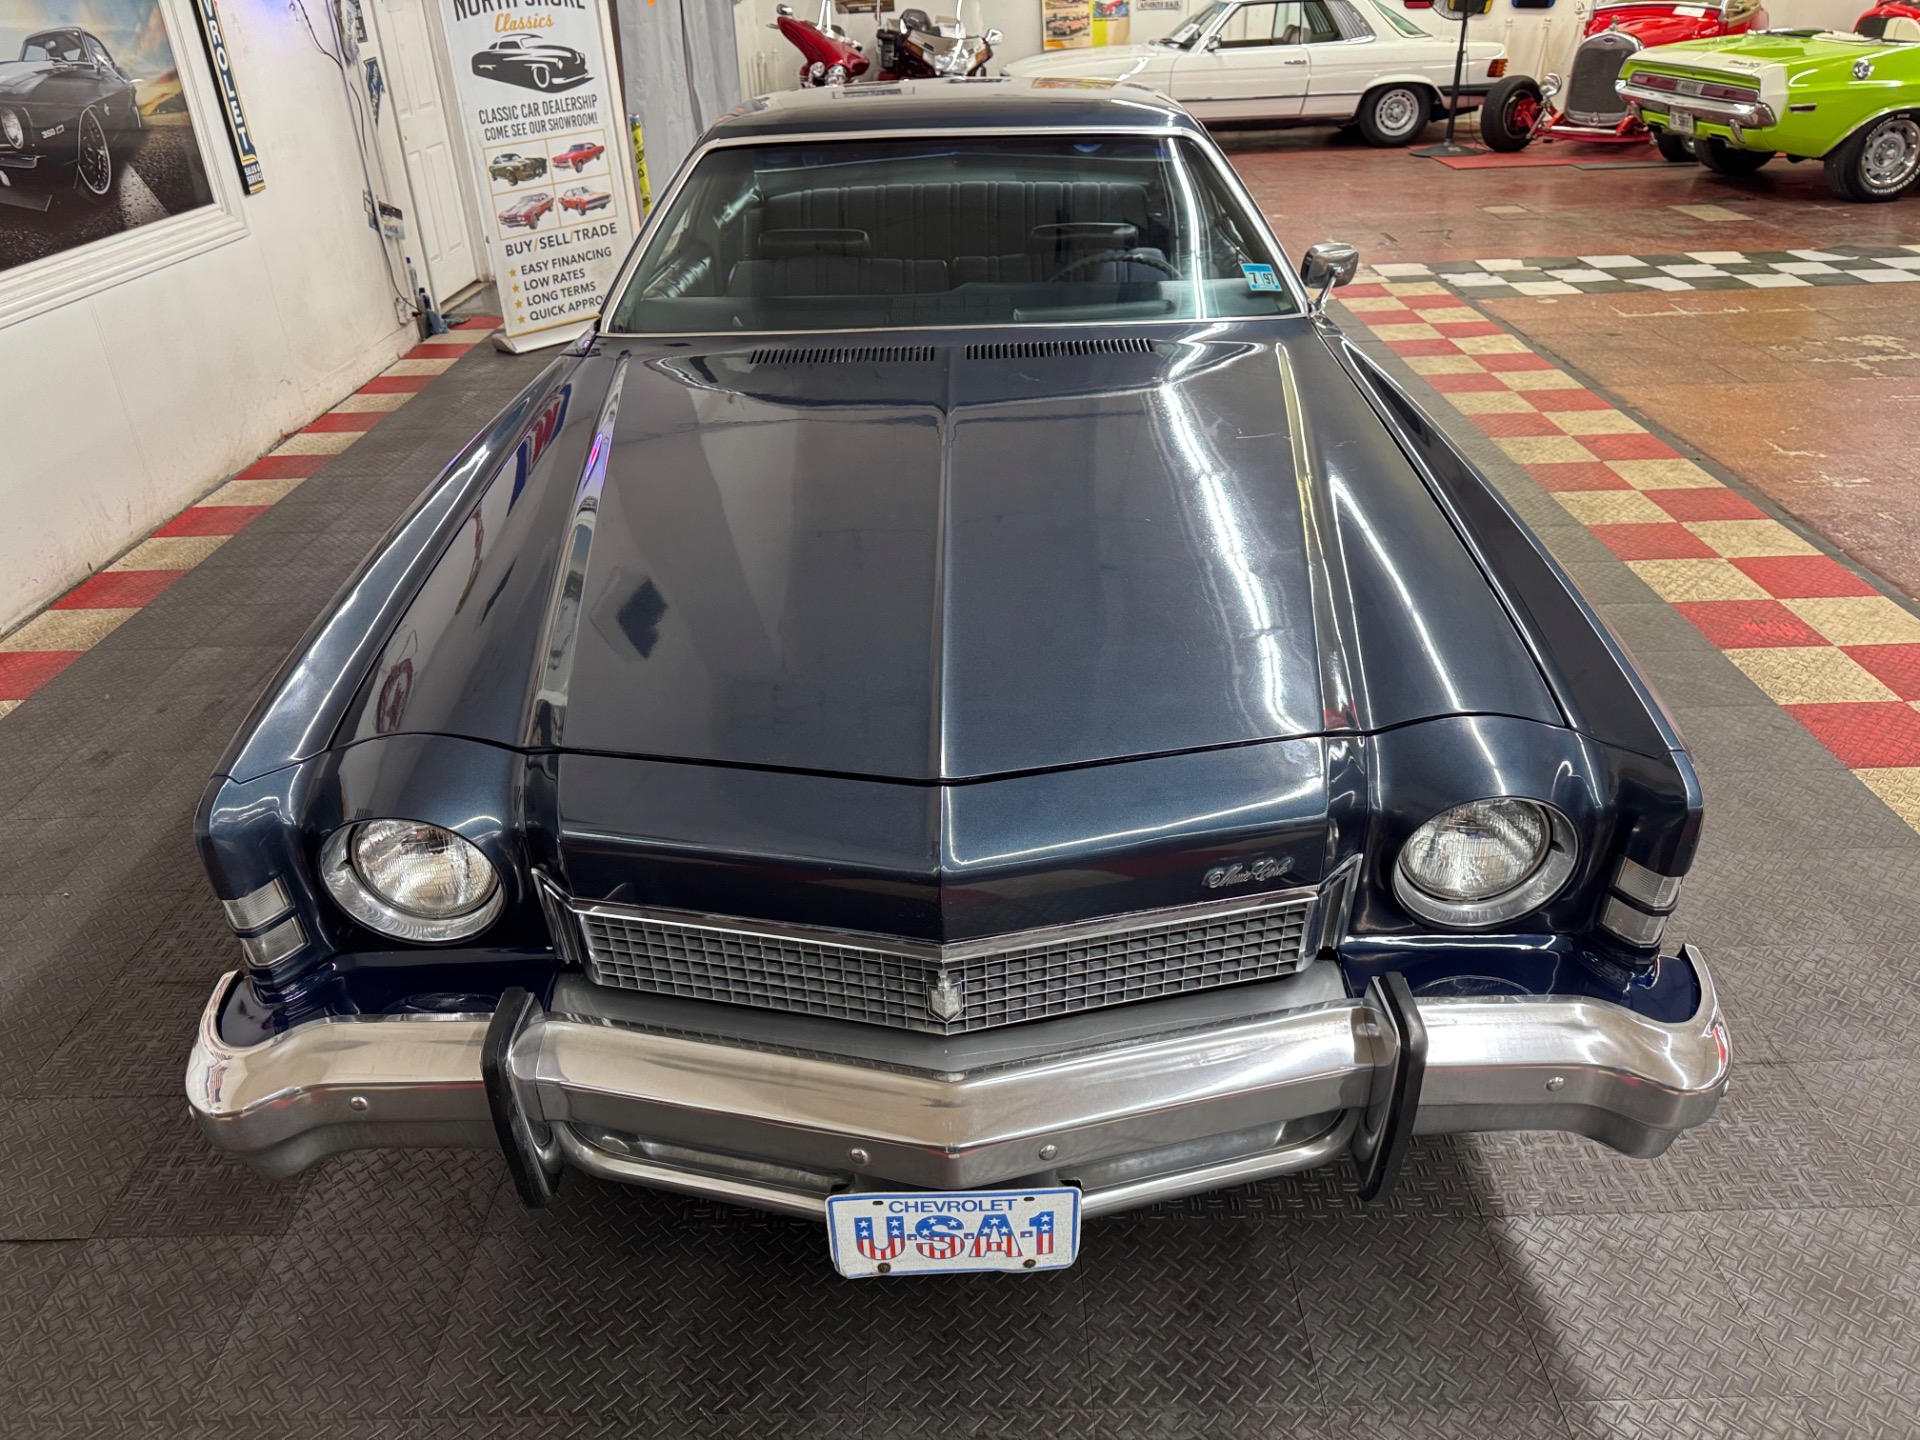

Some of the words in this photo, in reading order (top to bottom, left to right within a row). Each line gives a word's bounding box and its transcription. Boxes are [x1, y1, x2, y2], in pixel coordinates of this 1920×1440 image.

[495, 13, 554, 33] Classics
[479, 105, 519, 125] CLASSIC
[521, 102, 540, 118] CAR
[542, 94, 597, 116] DEALERSHIP
[484, 125, 510, 141] COME
[511, 123, 528, 137] SEE
[529, 120, 547, 134] OUR
[548, 112, 598, 131] SHOWROOM!
[521, 259, 549, 275] EASY
[552, 246, 612, 269] FINANCING
[524, 276, 550, 291] LOW
[552, 268, 586, 285] RATES
[1249, 272, 1258, 284] 7
[1263, 272, 1275, 285] 97
[527, 290, 558, 306] LONG
[560, 281, 596, 298] TERMS
[530, 304, 566, 321] QUICK
[568, 294, 605, 312] APPRO
[888, 1199, 1018, 1214] CHEVROLET
